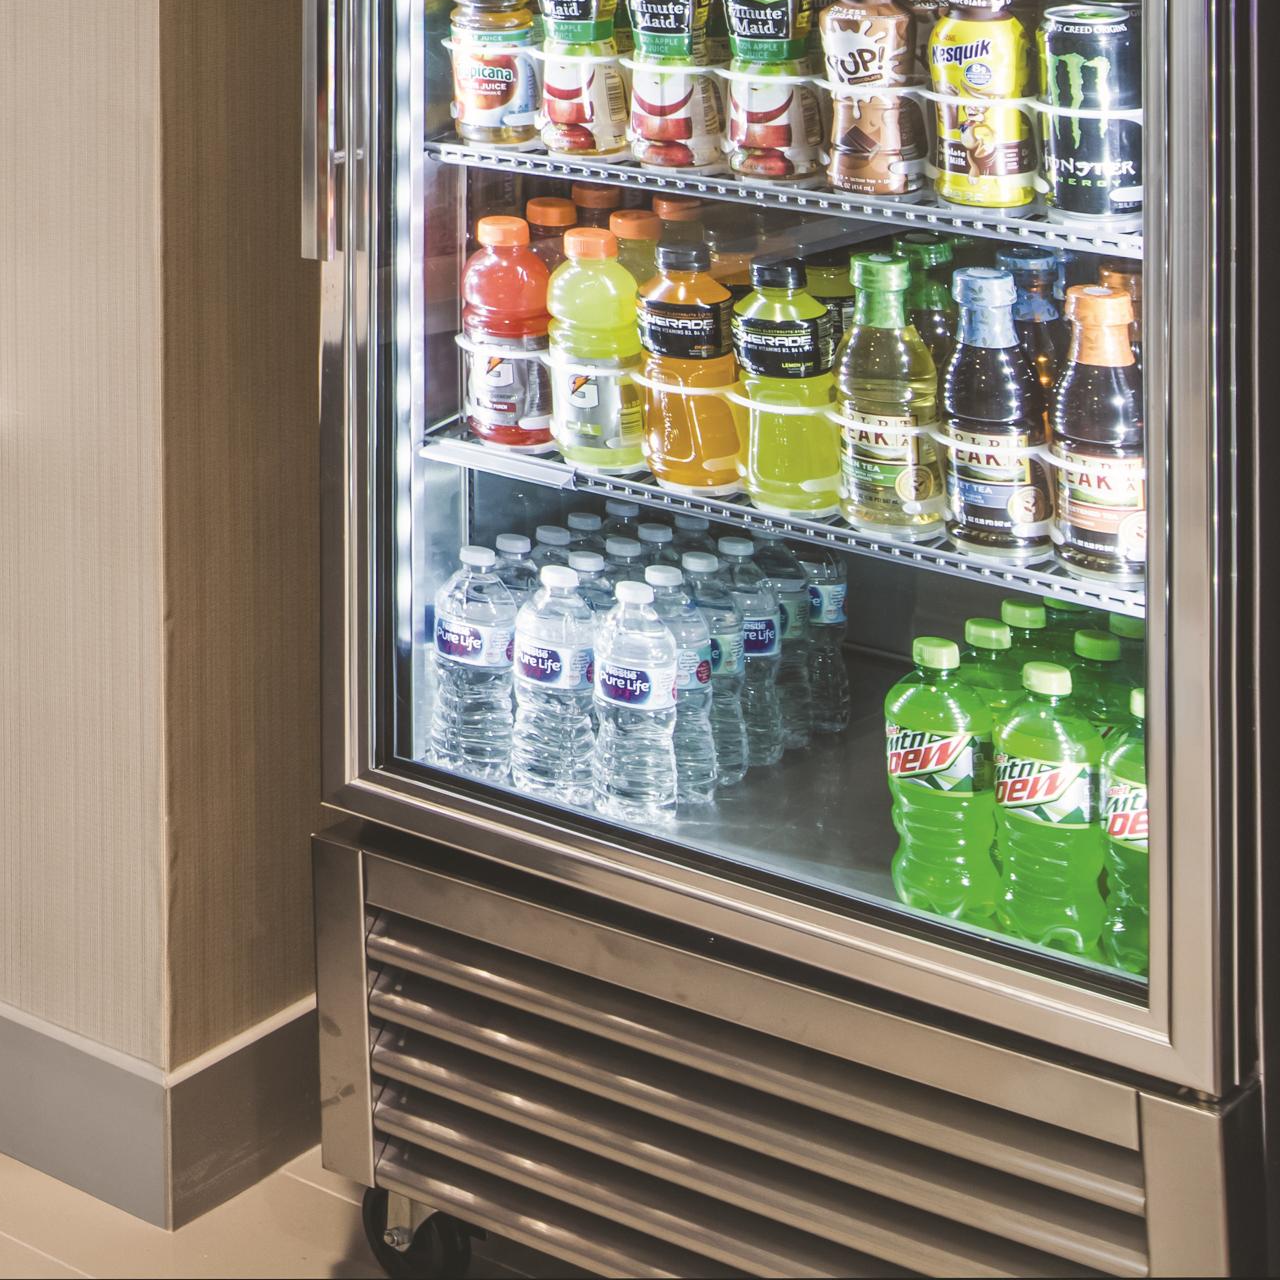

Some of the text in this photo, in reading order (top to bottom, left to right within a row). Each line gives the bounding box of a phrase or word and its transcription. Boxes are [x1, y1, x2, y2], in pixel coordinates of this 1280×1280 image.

[1062, 23, 1128, 34] CREED ORIGINS
[863, 464, 880, 473] TEA
[973, 486, 992, 494] TEA
[437, 629, 482, 650] Pure Life
[539, 655, 561, 672] Life
[600, 670, 649, 694] Pure Life
